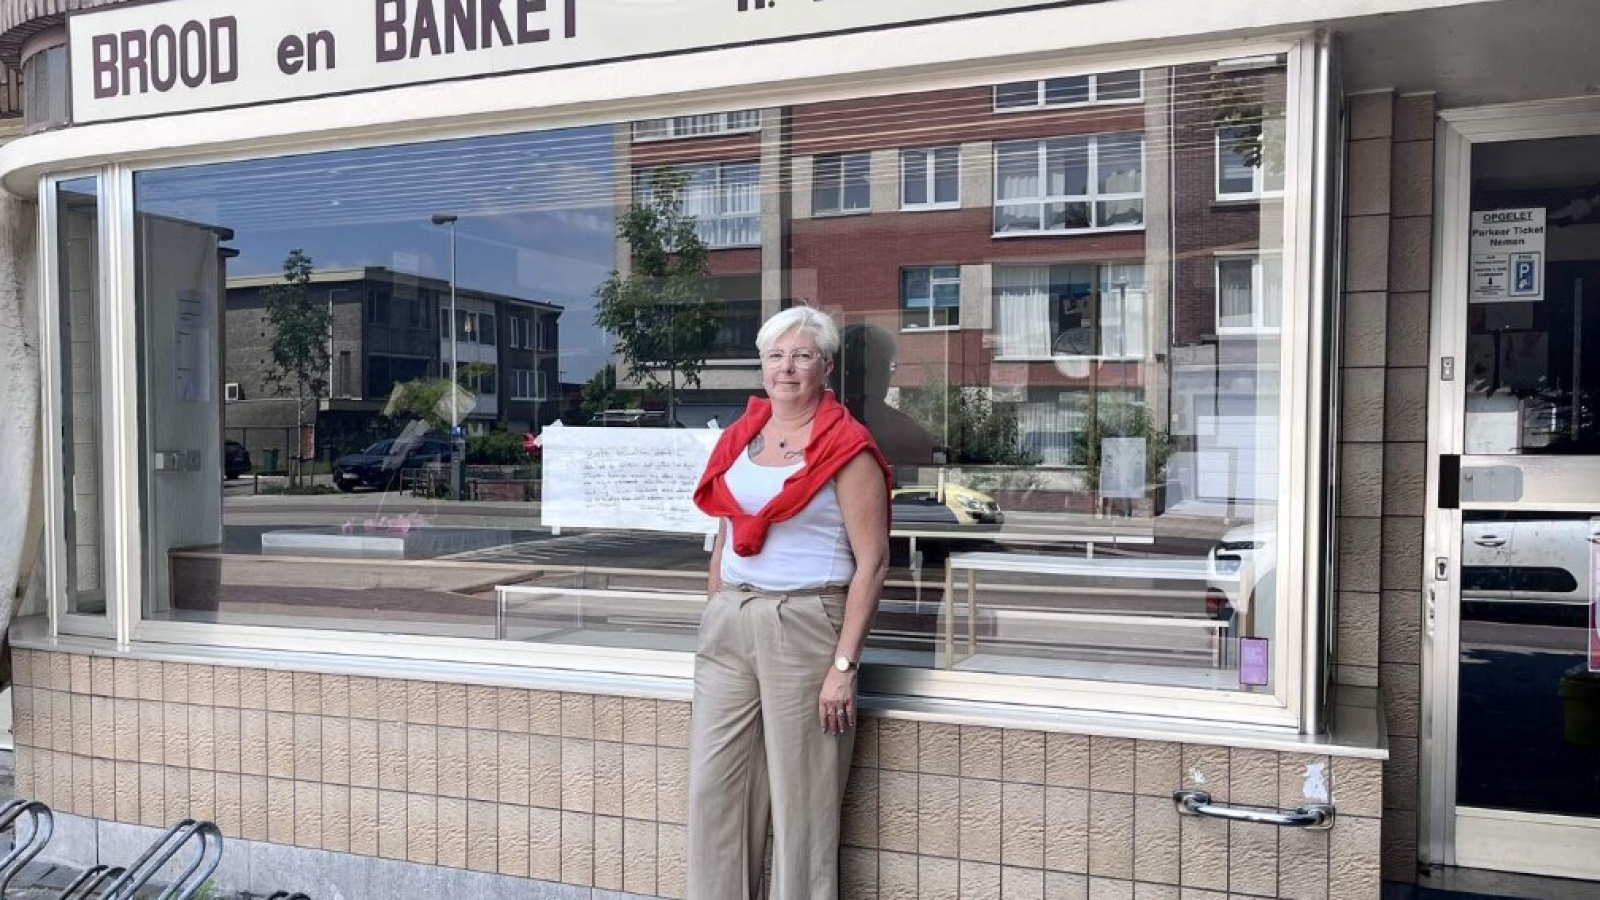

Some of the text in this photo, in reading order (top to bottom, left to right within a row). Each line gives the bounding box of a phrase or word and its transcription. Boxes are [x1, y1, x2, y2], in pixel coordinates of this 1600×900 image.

[92, 0, 577, 99] BROOD en BANKET
[1483, 211, 1533, 221] OPGELET
[1472, 226, 1544, 237] Parkeer Ticket
[1490, 238, 1525, 246] Nemen
